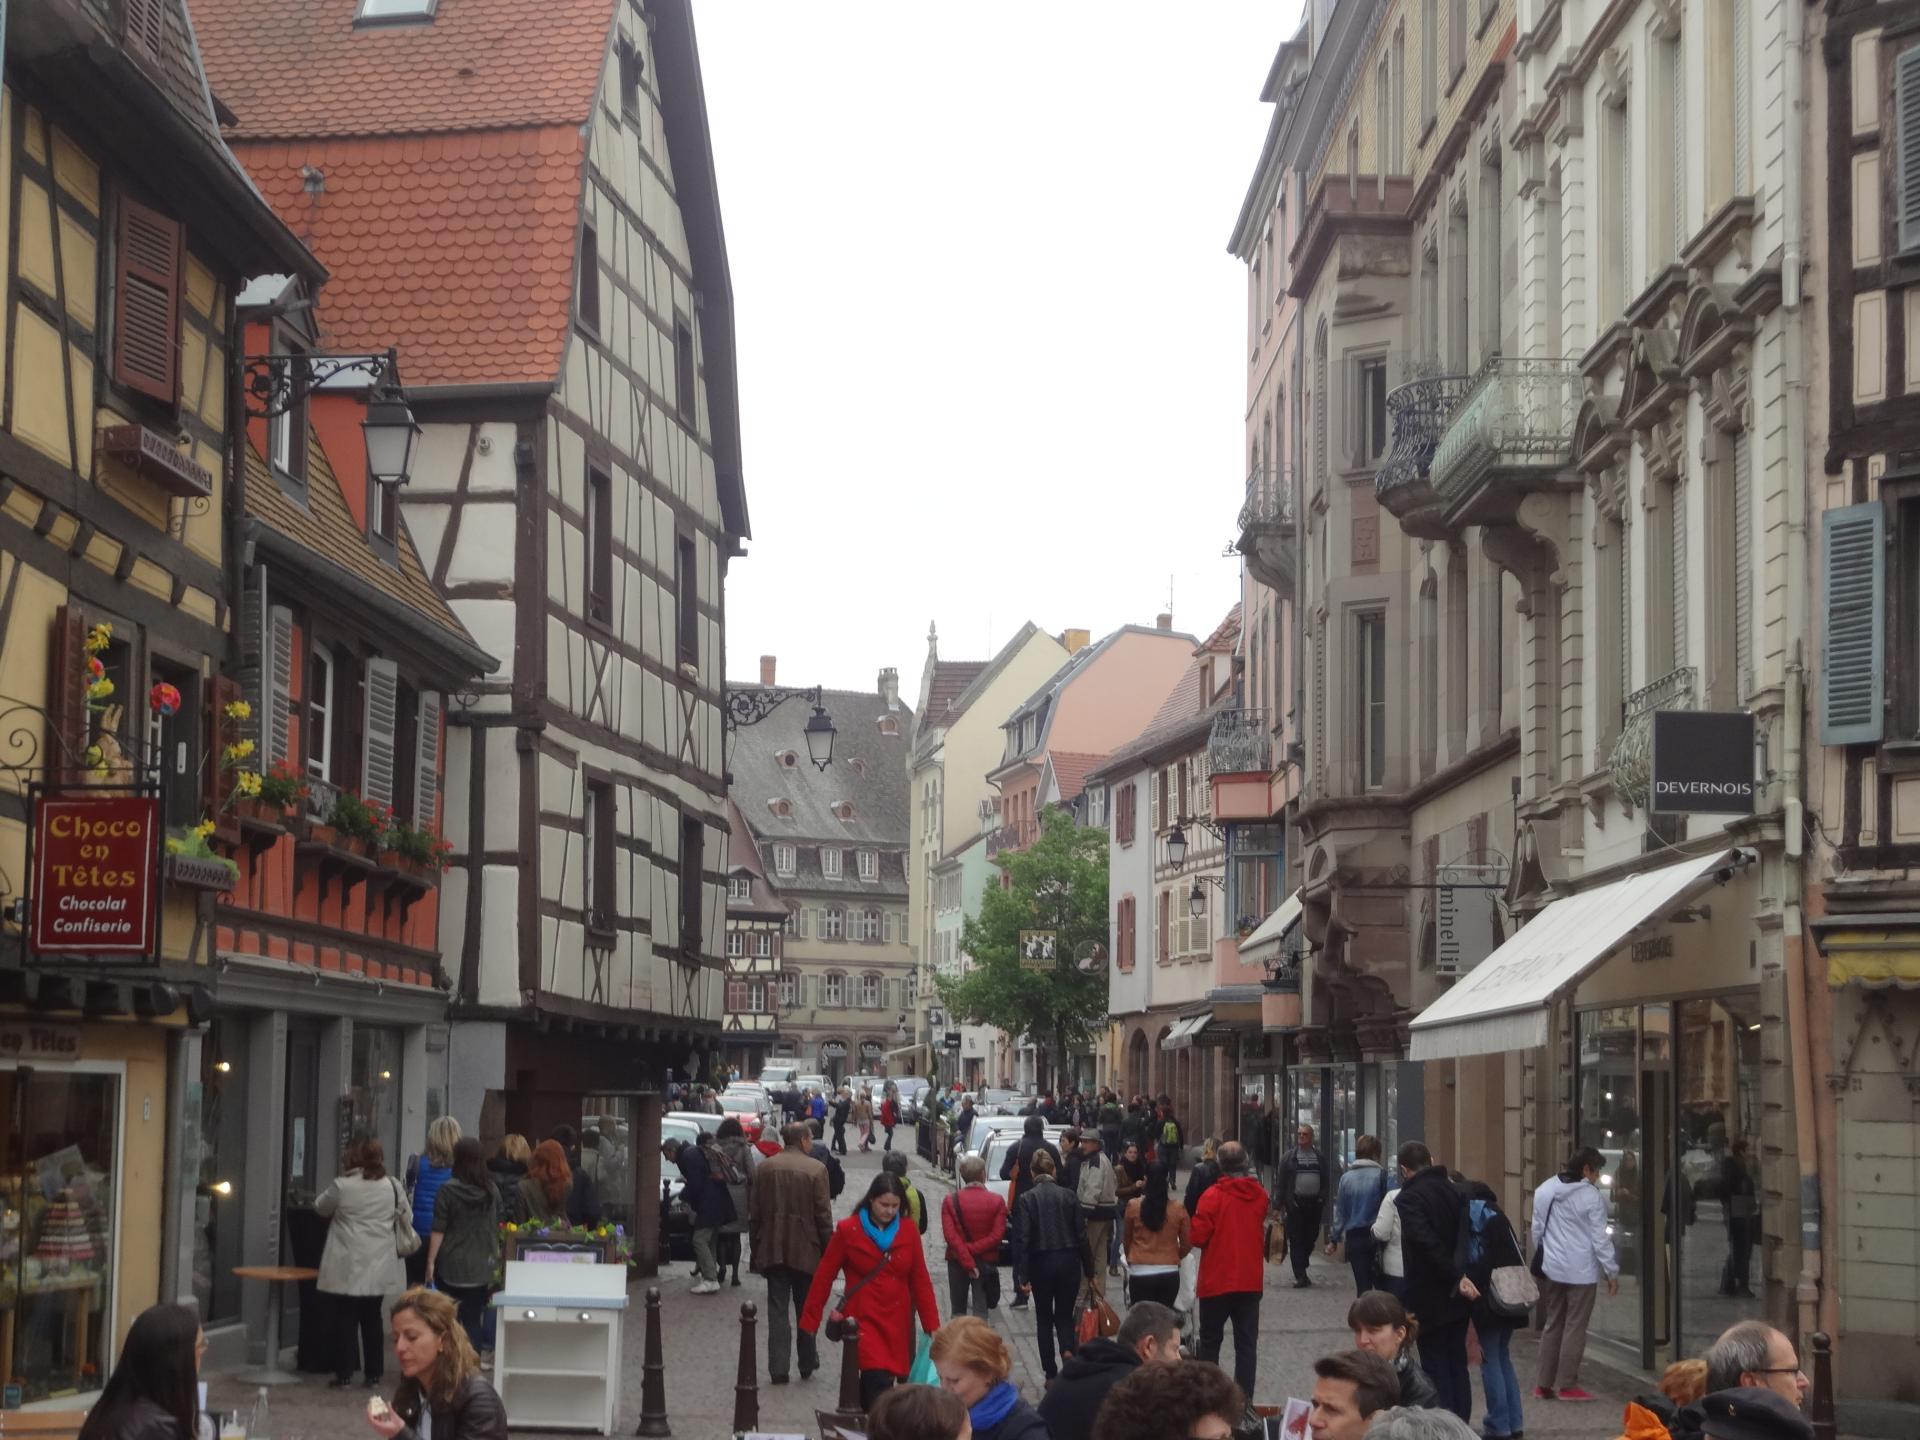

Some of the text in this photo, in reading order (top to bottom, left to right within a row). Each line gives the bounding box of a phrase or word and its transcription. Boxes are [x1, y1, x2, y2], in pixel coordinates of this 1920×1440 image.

[1656, 781, 1752, 796] DEVERNOIS
[50, 815, 141, 840] Choco
[80, 844, 110, 860] en
[52, 865, 136, 887] Têtes
[59, 895, 127, 911] Chocolat
[53, 916, 131, 933] Confiserie
[1440, 885, 1459, 962] minelli
